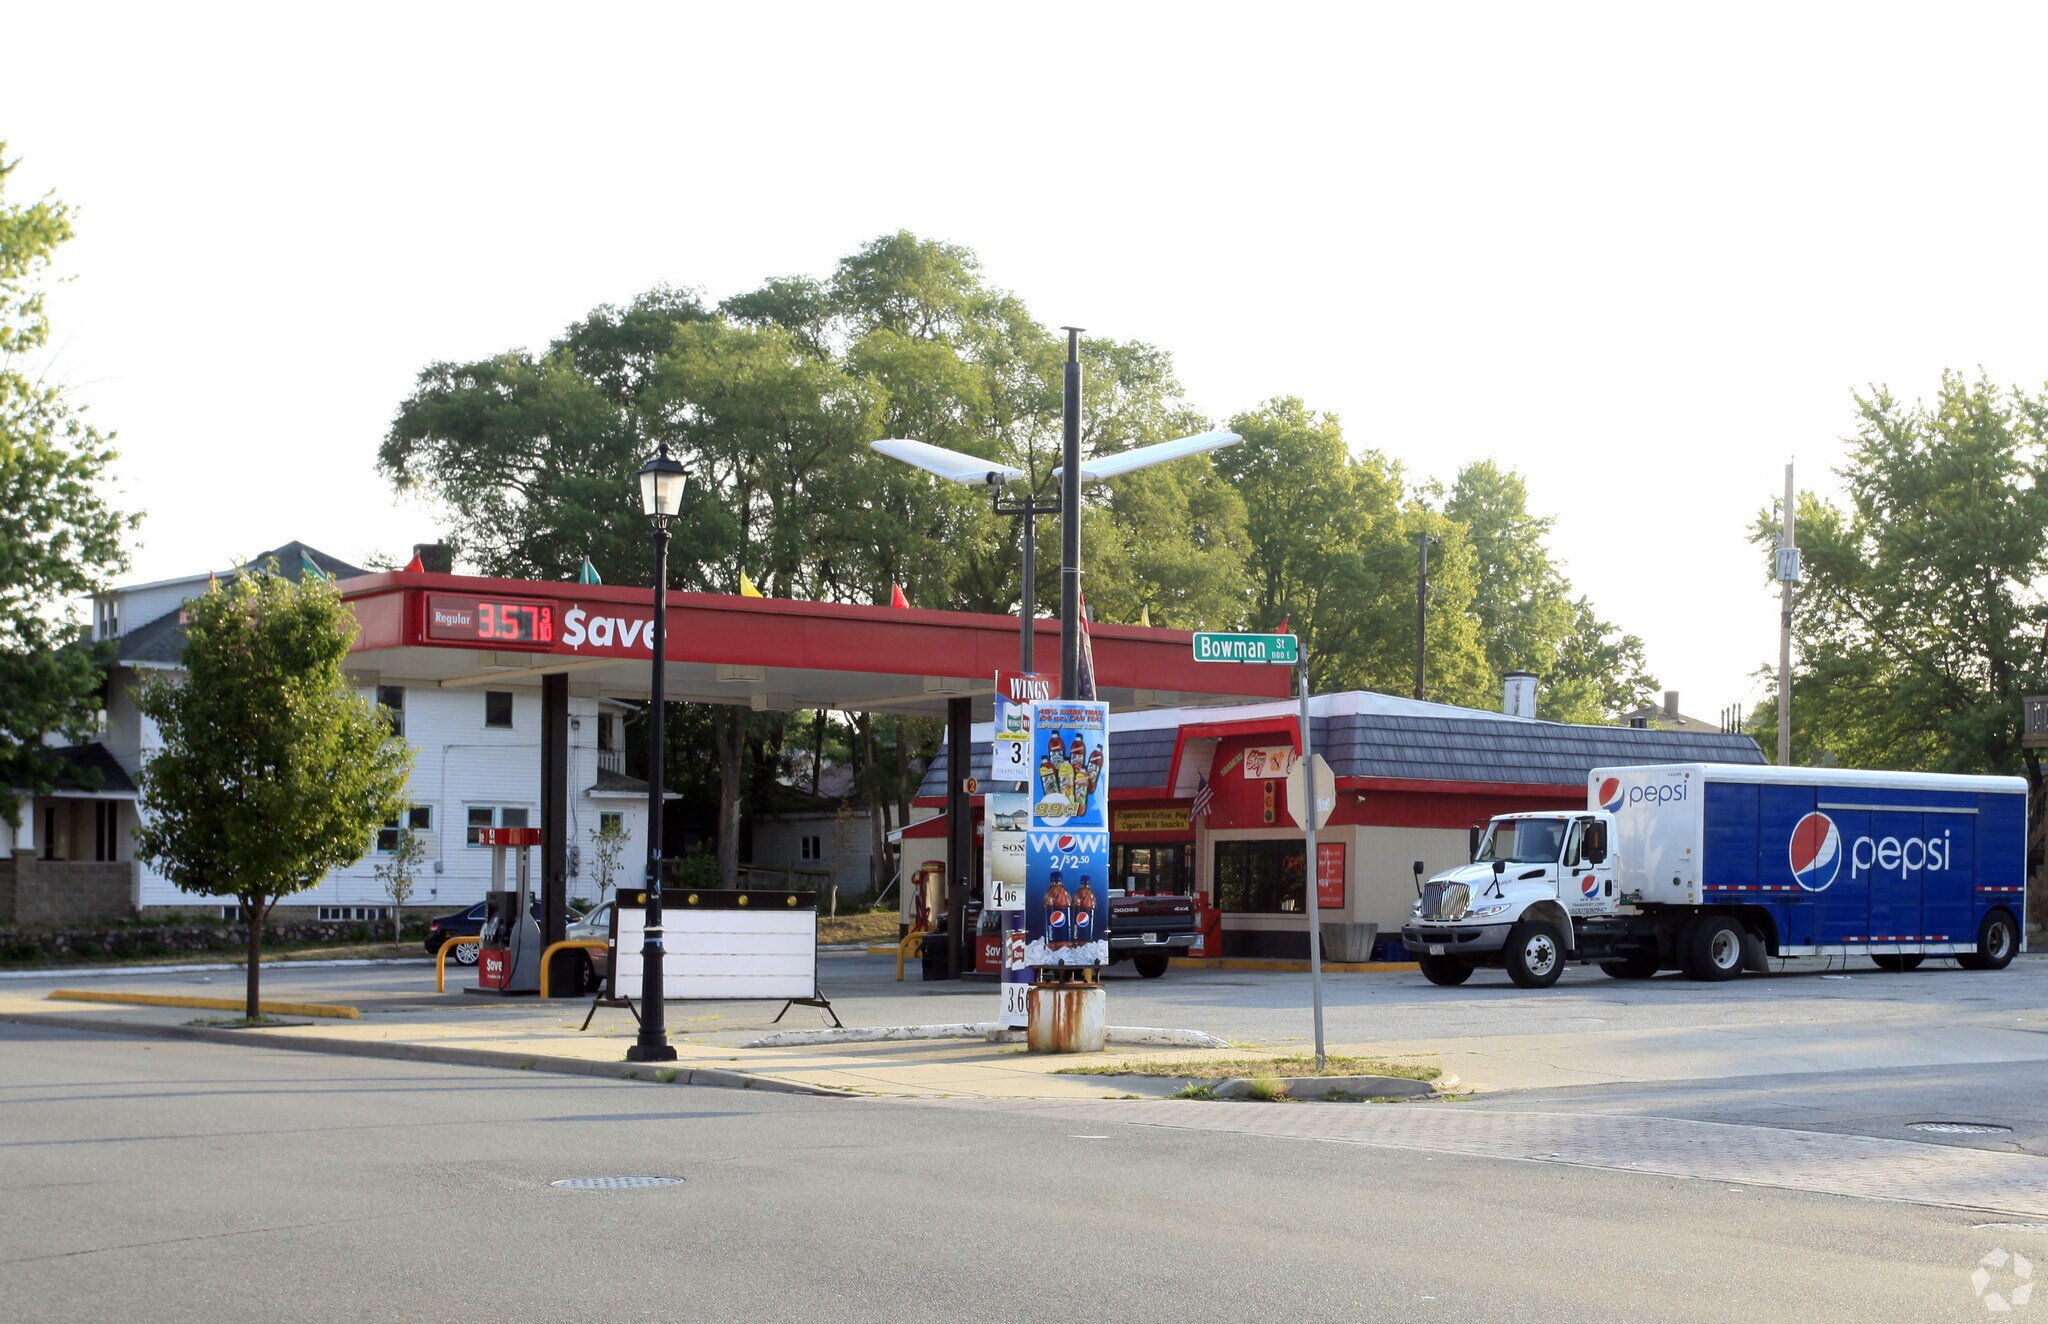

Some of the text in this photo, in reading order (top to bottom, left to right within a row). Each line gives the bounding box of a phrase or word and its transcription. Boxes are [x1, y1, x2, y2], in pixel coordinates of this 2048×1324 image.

[435, 611, 471, 626] Regular
[478, 603, 539, 641] 3.57
[1201, 636, 1285, 659] Bowman St
[1271, 651, 1290, 660] 1100 E
[1010, 678, 1049, 701] WINGS
[969, 780, 975, 791] 2
[1629, 780, 1687, 808] pepsi
[1851, 829, 1951, 880] pepsi
[985, 943, 1001, 957] $av
